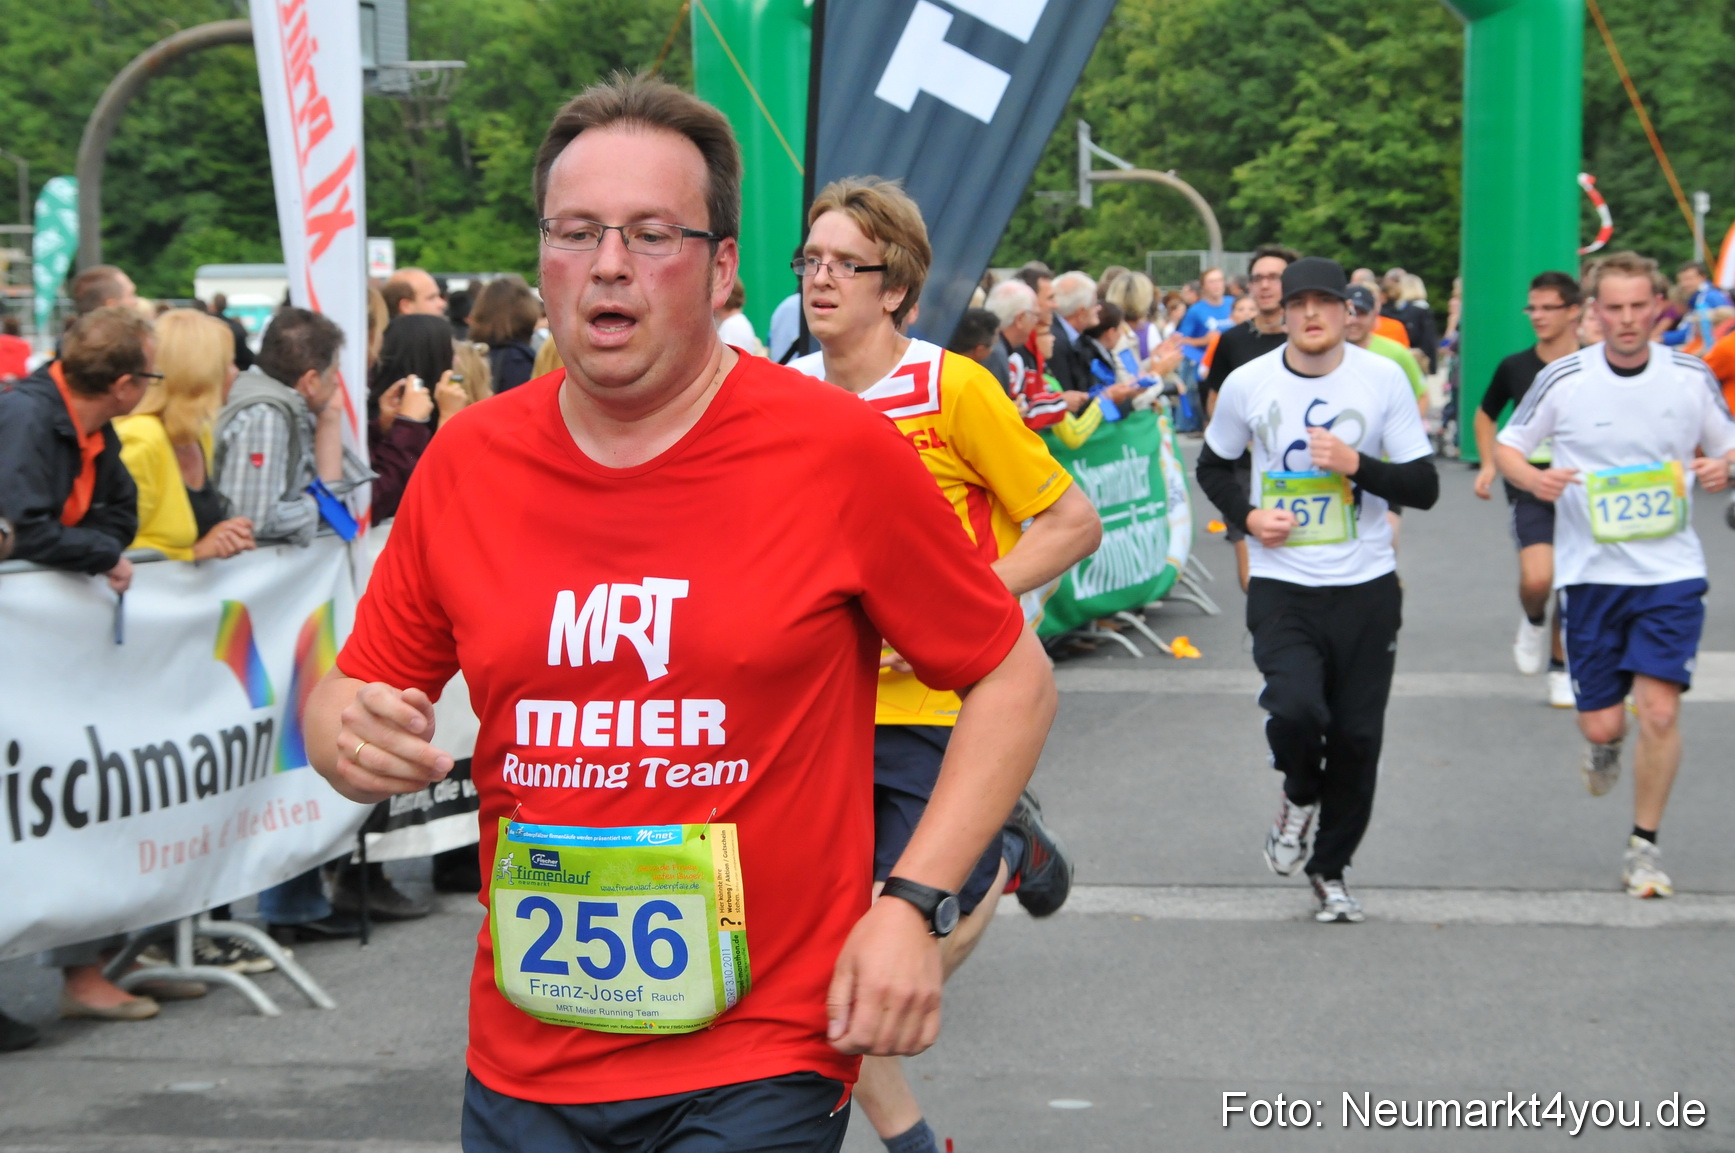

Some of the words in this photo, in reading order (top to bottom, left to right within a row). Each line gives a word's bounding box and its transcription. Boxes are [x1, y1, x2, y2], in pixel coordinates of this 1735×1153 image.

[1596, 489, 1674, 523] 1232
[547, 576, 689, 682] MRT
[515, 698, 726, 747] MEIER
[0, 717, 273, 842] ischmann
[503, 752, 631, 789] Running
[638, 757, 749, 788] Team
[138, 824, 210, 875] Druck
[235, 798, 322, 842] Medien
[517, 865, 591, 885] firmenlauf
[725, 887, 733, 913] Werbung
[515, 895, 689, 981] 256
[721, 948, 735, 986] 3.10.2011
[529, 977, 644, 1002] Franz-Josef
[651, 992, 685, 1002] Rauch
[556, 1004, 573, 1012] MRT
[575, 1006, 597, 1015] Meier
[599, 1007, 634, 1018] Running
[635, 1009, 660, 1017] Team
